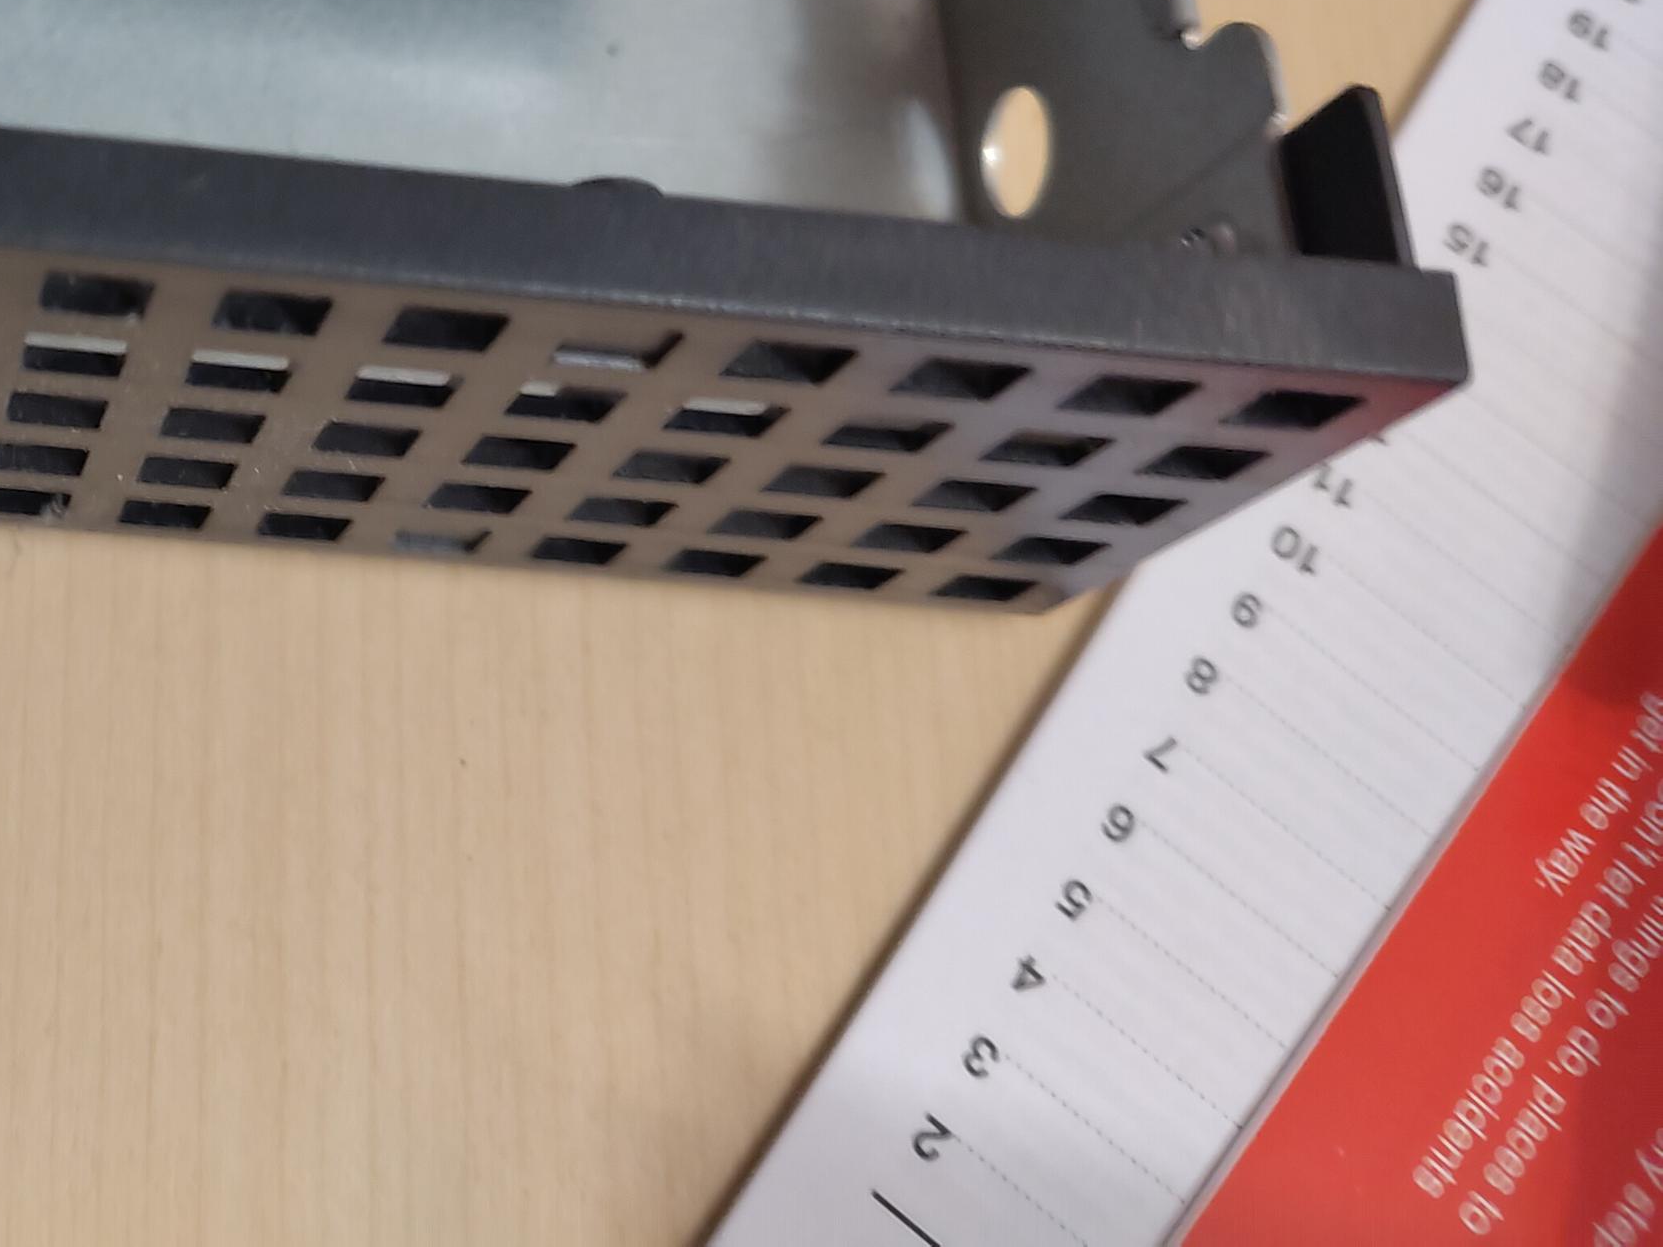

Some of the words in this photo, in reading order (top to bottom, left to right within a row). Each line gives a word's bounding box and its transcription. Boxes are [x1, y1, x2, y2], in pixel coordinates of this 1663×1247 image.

[1567, 9, 1611, 51] 19
[1506, 118, 1552, 155] 17
[1476, 166, 1522, 212] 16
[1443, 222, 1491, 267] 15
[1270, 525, 1319, 575] 10
[1231, 592, 1263, 629] 9
[1185, 655, 1219, 695] 8
[1143, 737, 1178, 774] 7
[1612, 746, 1652, 781] in
[1101, 804, 1136, 842] 6
[1581, 776, 1632, 831] the
[1055, 879, 1093, 921] 5
[1553, 900, 1612, 975] data
[1010, 955, 1047, 992] 4
[1512, 969, 1576, 1042] loss
[1587, 989, 1629, 1029] to
[962, 1035, 1000, 1078] 3
[912, 1111, 954, 1162] 2
[1414, 1037, 1525, 1198] accidents
[1484, 1074, 1566, 1195] places
[1460, 1190, 1504, 1234] to
